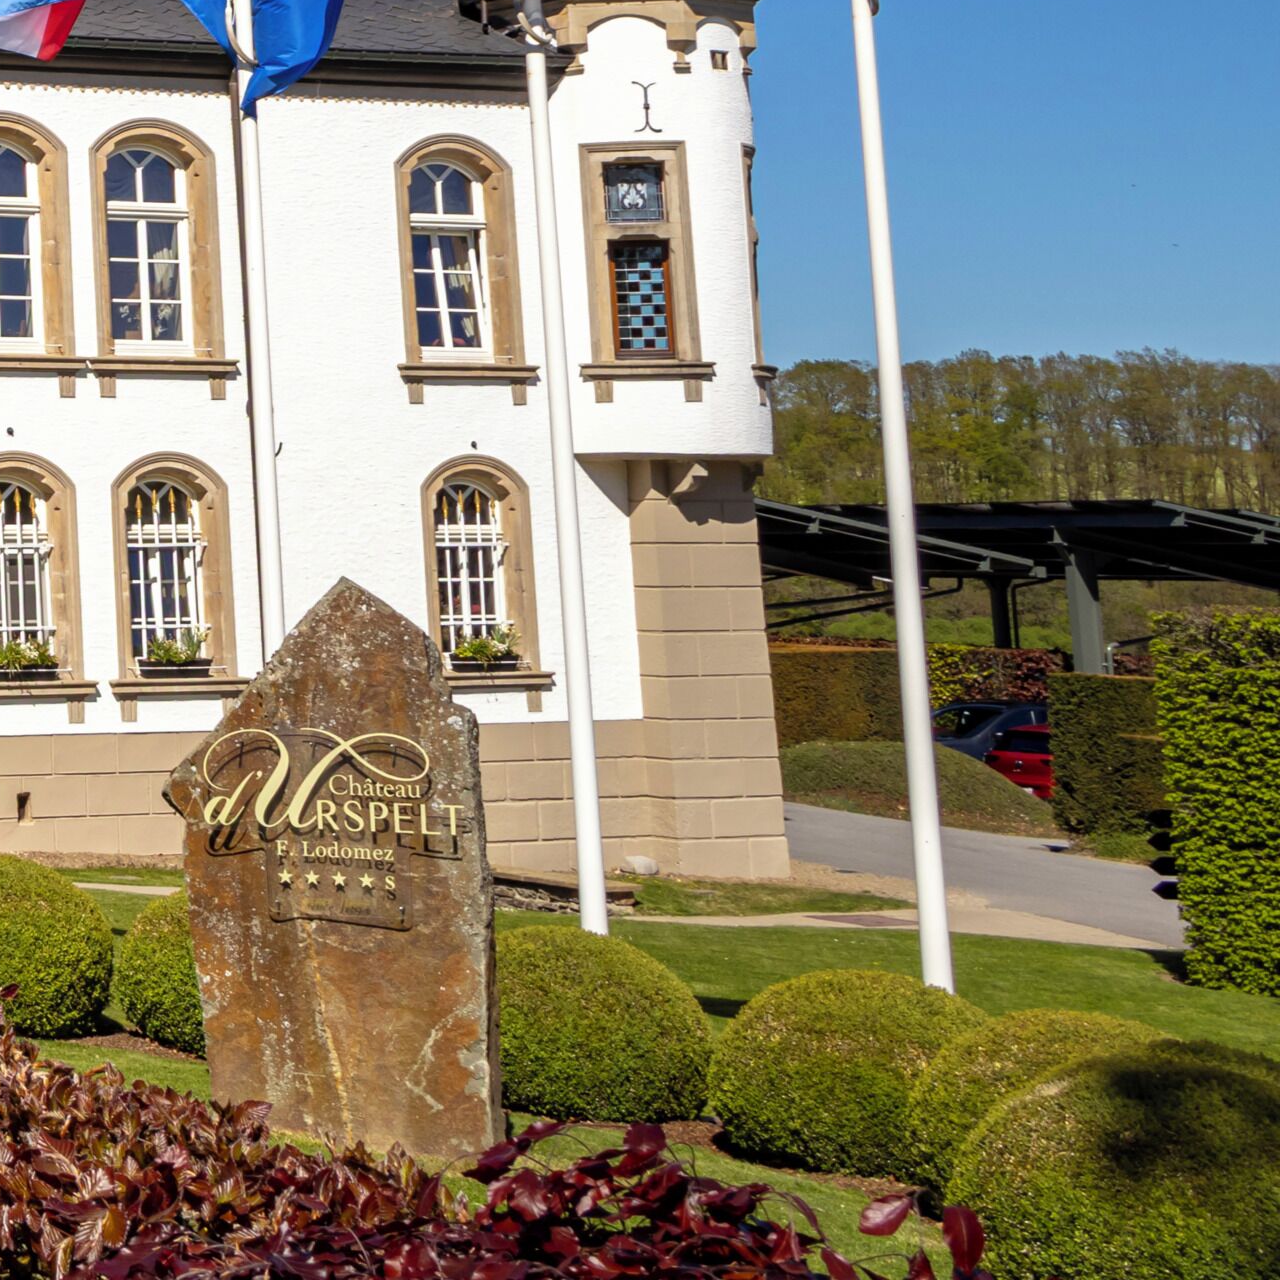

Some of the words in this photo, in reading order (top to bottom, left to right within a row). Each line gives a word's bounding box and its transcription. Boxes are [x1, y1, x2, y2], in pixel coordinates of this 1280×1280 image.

[328, 773, 422, 799] Château
[275, 839, 295, 857] F.
[301, 840, 395, 861] Lodomez
[384, 875, 396, 890] S
